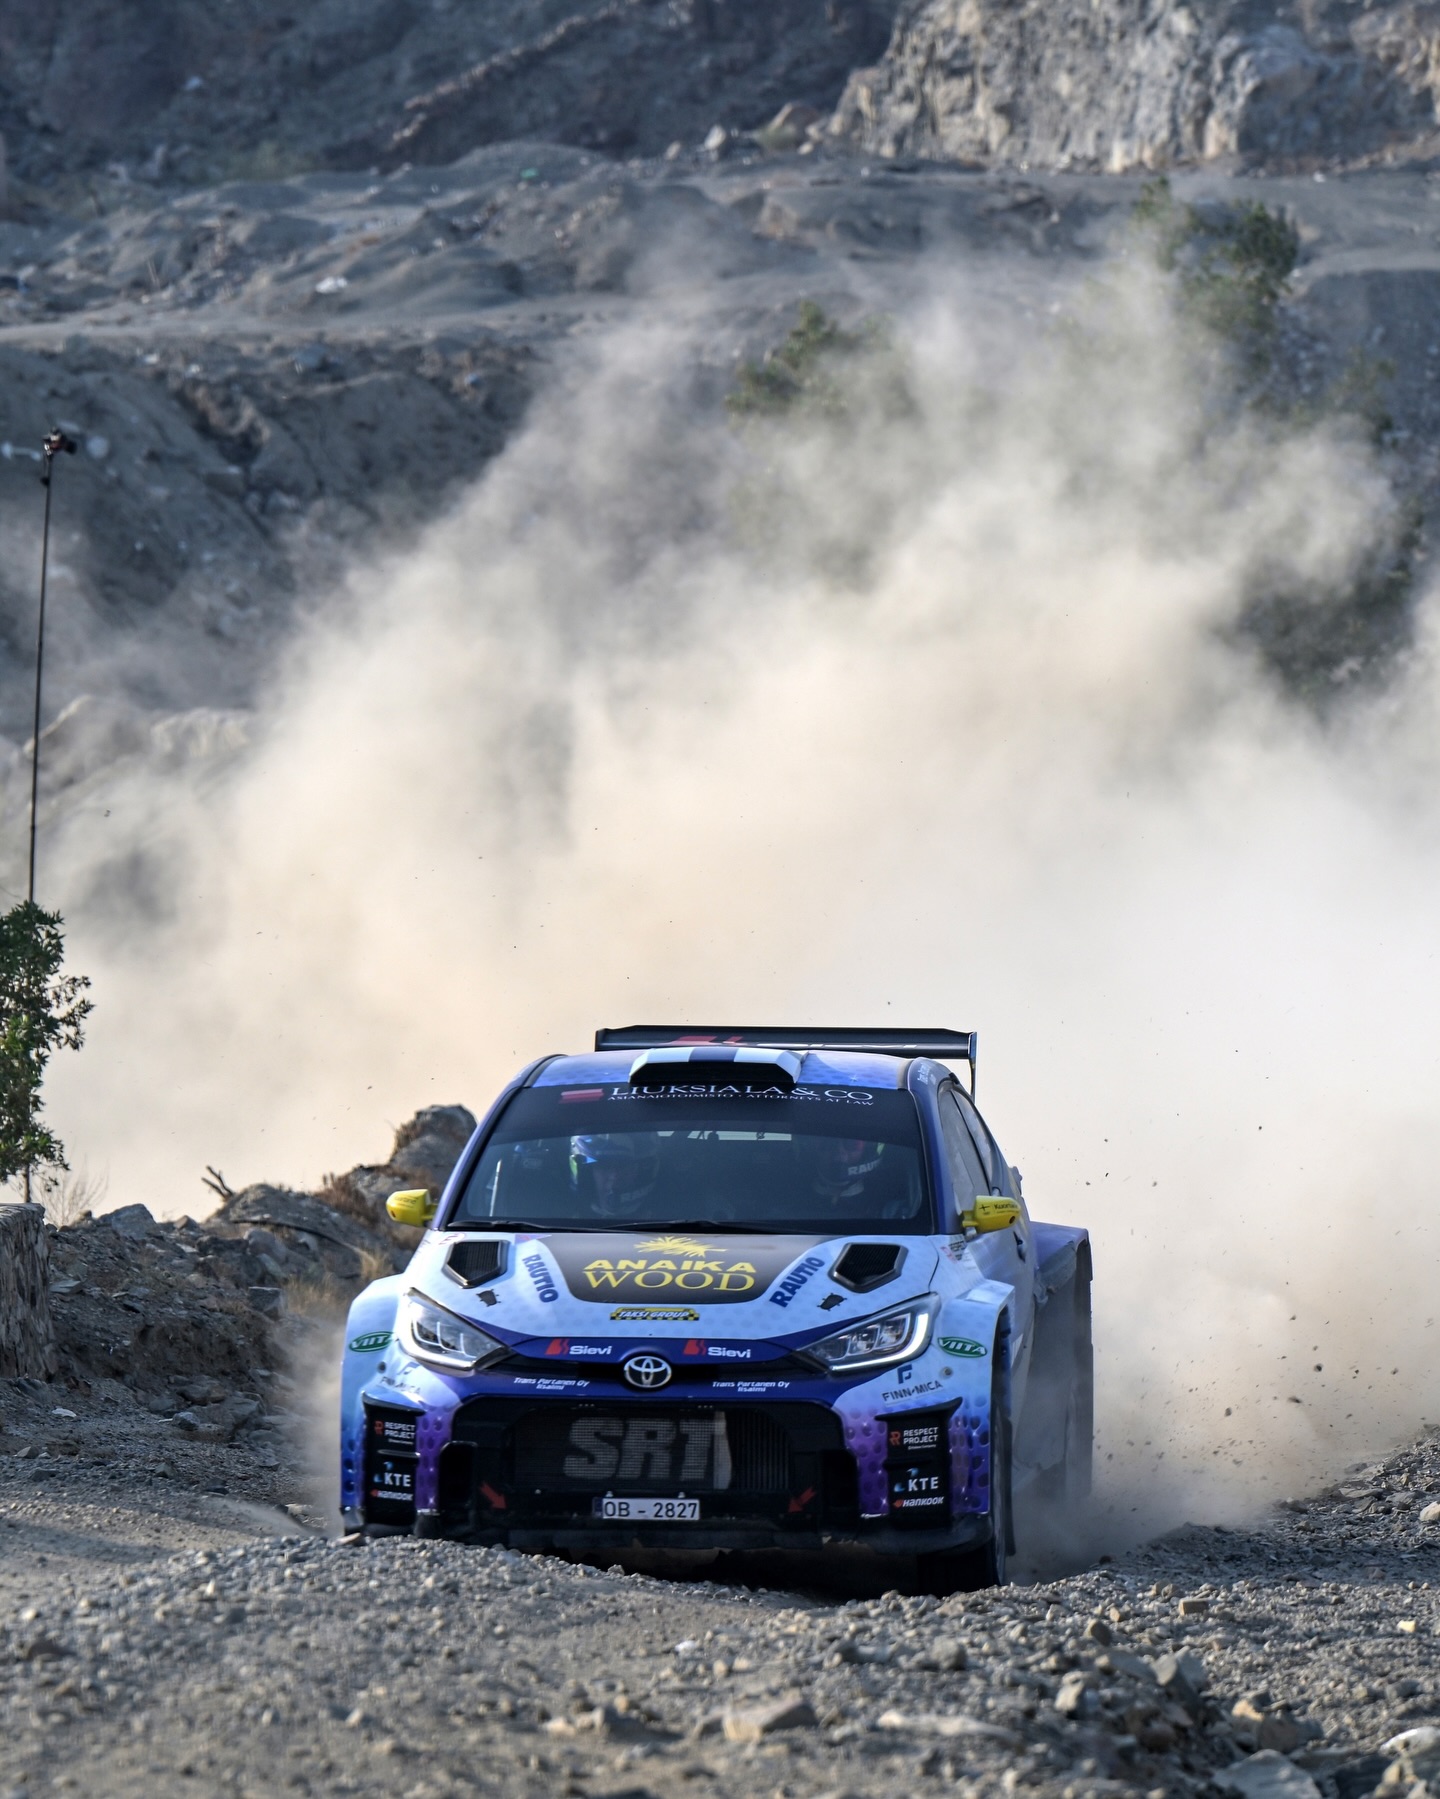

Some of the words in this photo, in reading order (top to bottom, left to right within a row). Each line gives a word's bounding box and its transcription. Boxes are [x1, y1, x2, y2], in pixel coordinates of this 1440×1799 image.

[791, 1087, 820, 1097] &
[824, 1089, 873, 1101] CO
[583, 1259, 757, 1273] ANAIKA
[522, 1254, 559, 1303] RAUTIO
[583, 1271, 755, 1291] WOOD
[769, 1256, 825, 1308] RAUTIO
[351, 1335, 392, 1348] VIIT
[939, 1338, 986, 1355] VIITA
[569, 1345, 611, 1356] Sievi
[707, 1346, 751, 1358] Sievi
[384, 1421, 415, 1431] RESPECT
[903, 1426, 939, 1437] RESPECT
[384, 1429, 415, 1439] PROJECT
[903, 1434, 939, 1445] PROJECT
[563, 1417, 727, 1480] SRT
[384, 1472, 411, 1487] KTE
[908, 1476, 939, 1492] KTE
[604, 1501, 630, 1517] OB
[653, 1502, 698, 1518] 2827
